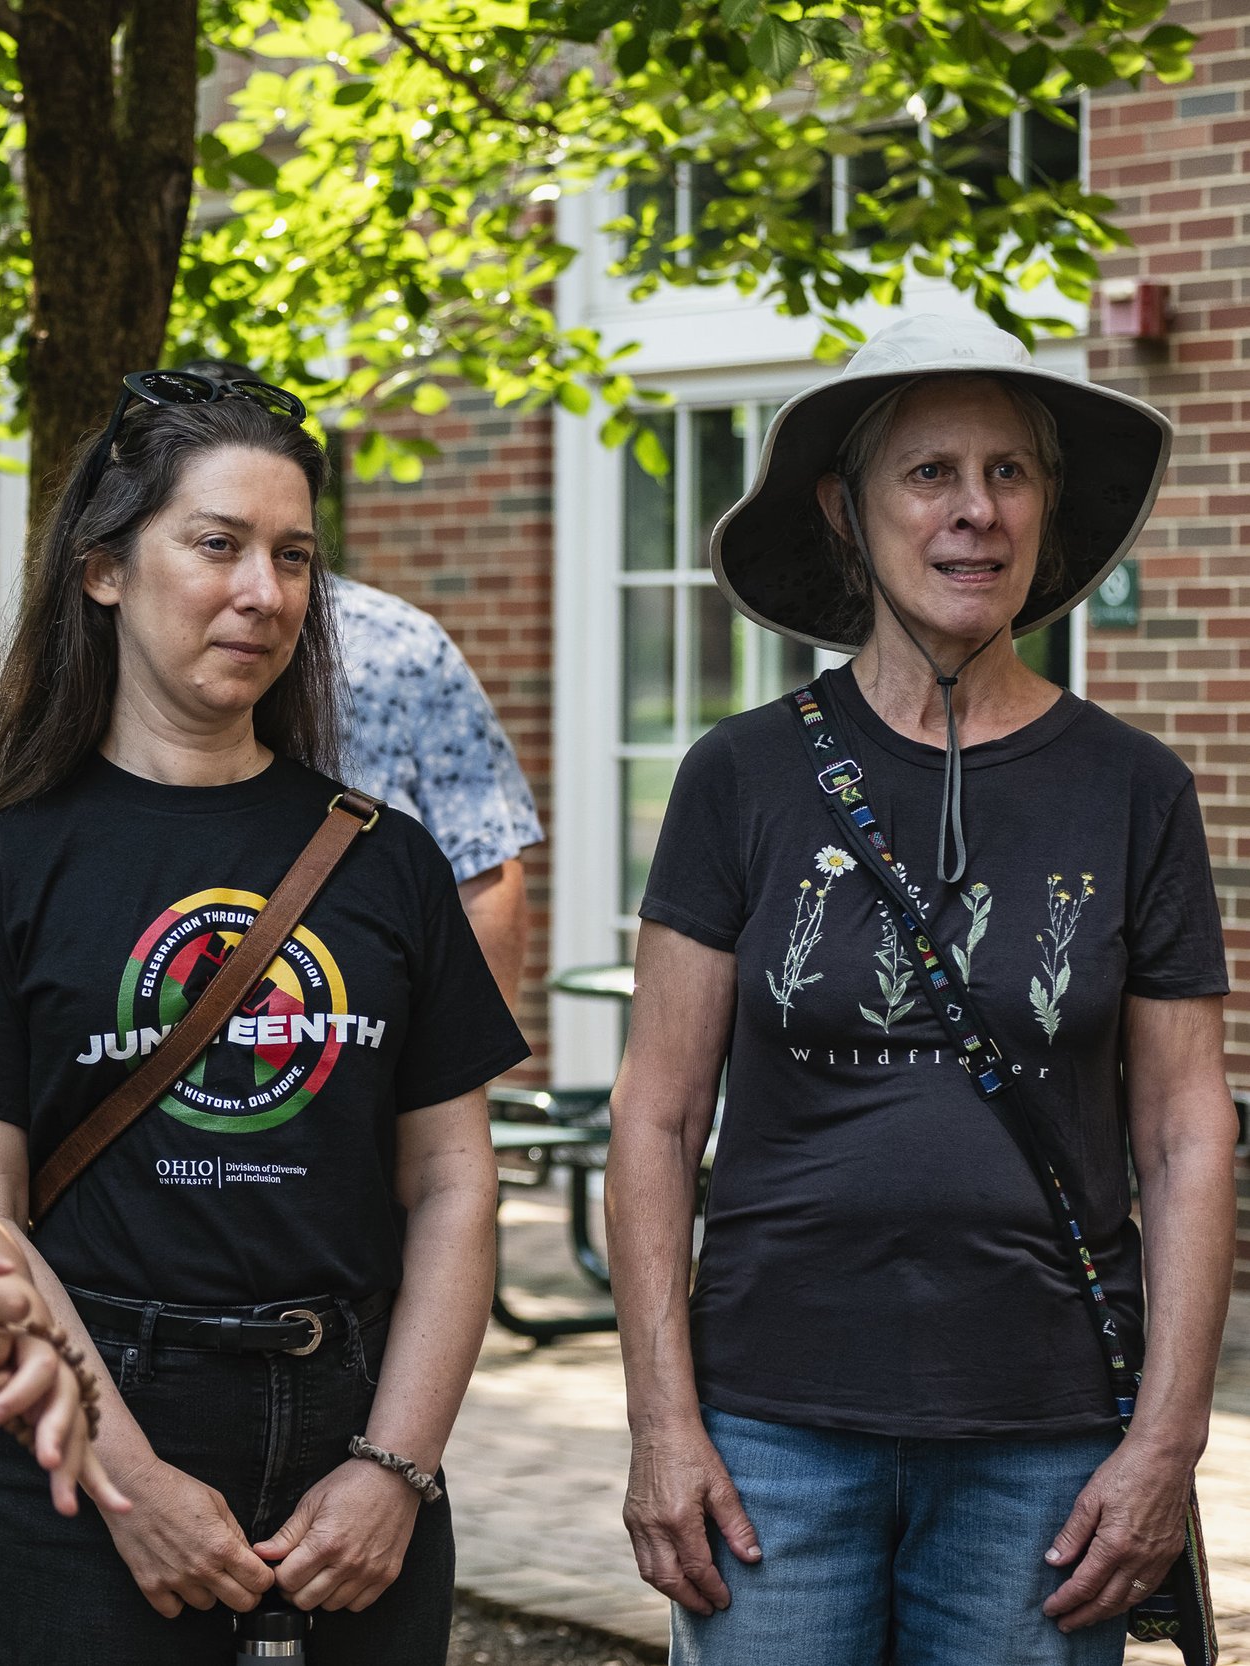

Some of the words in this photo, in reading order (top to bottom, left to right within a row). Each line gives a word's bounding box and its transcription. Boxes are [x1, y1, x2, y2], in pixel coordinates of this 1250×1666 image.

[141, 916, 202, 998] CELEBRATION
[203, 910, 255, 927] THROUG
[76, 1012, 385, 1065] JUNEENTH
[184, 1087, 245, 1110] HISTORY.
[249, 1092, 272, 1108] OUR
[273, 1065, 306, 1098] HOPE.
[155, 1159, 214, 1177] OHIO
[225, 1162, 261, 1173] Division
[261, 1164, 271, 1173] of
[271, 1164, 307, 1177] Diversity
[159, 1177, 213, 1185] UNIVERSITY
[225, 1173, 242, 1182] and
[243, 1174, 281, 1184] Inclusion
